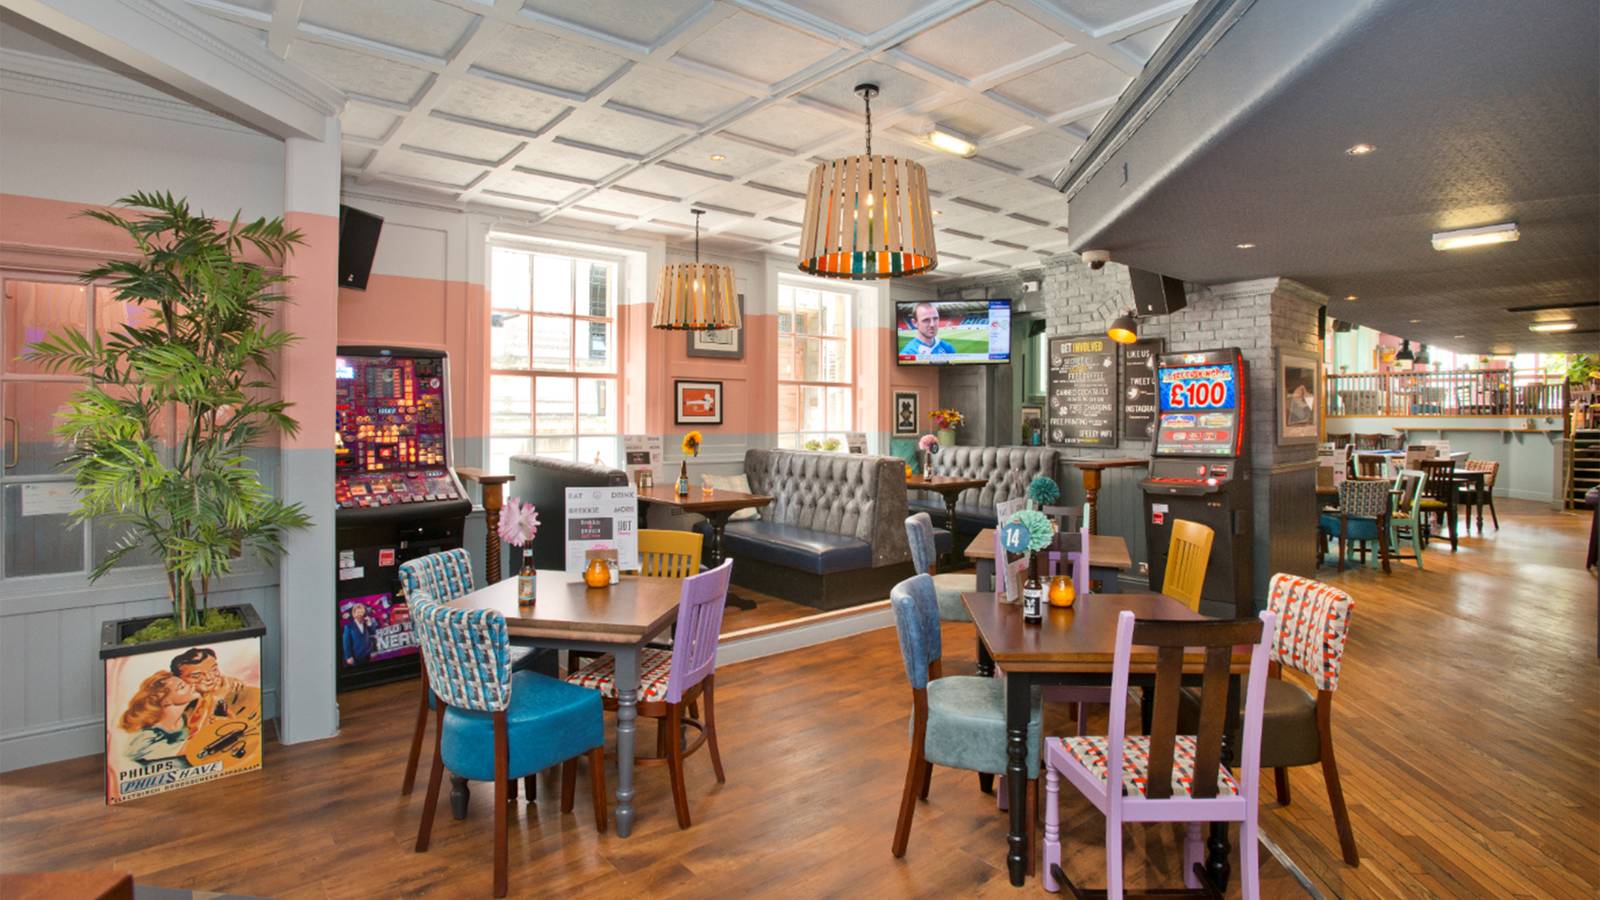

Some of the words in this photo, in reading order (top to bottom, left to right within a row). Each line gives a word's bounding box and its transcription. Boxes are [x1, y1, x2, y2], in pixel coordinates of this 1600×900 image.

[1061, 342, 1072, 353] GET
[1072, 341, 1104, 352] INVOLVED
[1126, 350, 1140, 359] LIKE
[1141, 350, 1150, 358] US
[1130, 377, 1150, 385] TWEET
[1170, 381, 1225, 406] £100
[1125, 405, 1155, 413] INSTAGRA
[1006, 528, 1020, 547] 14
[120, 761, 173, 781] PHILIPS
